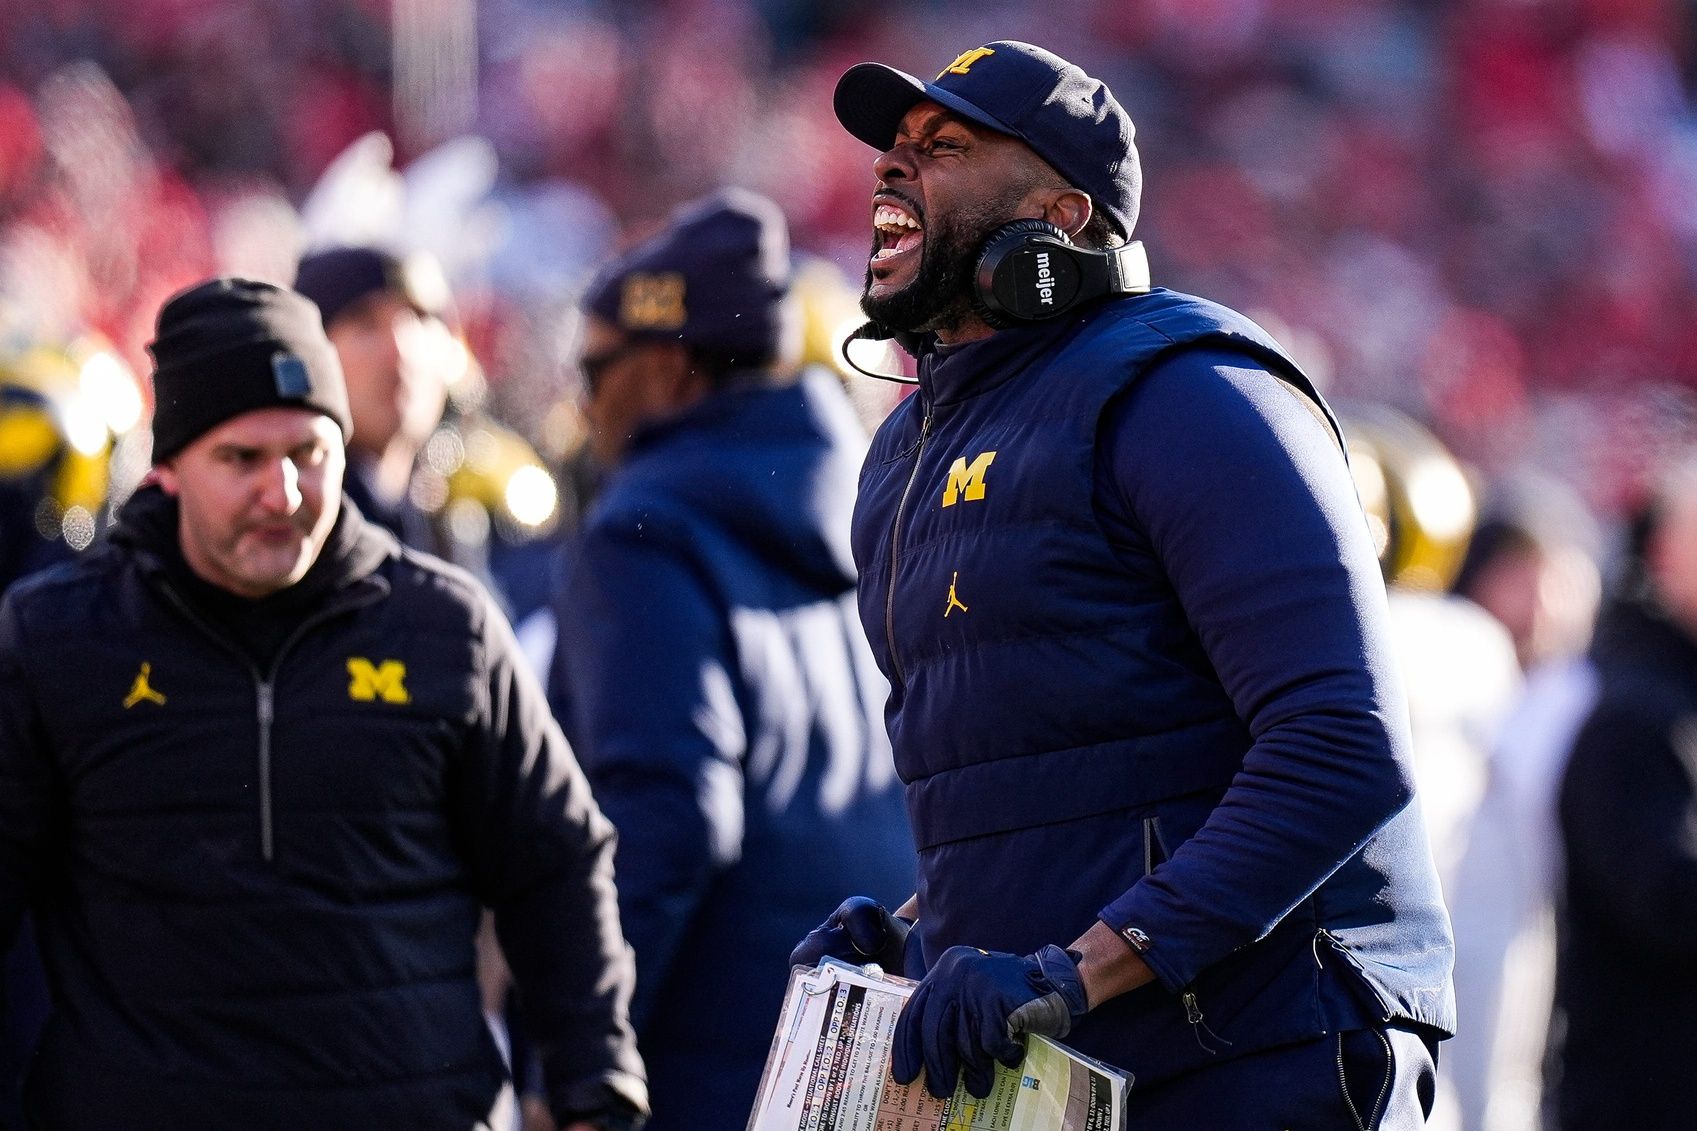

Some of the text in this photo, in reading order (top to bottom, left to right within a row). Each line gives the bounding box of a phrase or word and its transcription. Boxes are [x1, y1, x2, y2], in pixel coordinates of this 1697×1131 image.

[1035, 252, 1056, 305] meijer
[942, 451, 997, 508] M
[346, 657, 411, 704] M
[829, 1015, 840, 1034] OPP
[837, 1040, 844, 1049] UP
[828, 1099, 838, 1125] CONSULT
[834, 1082, 842, 1098] BOOK
[840, 1036, 853, 1069] INDIVIDUAL
[848, 1002, 861, 1037] SITUATIONS
[855, 1103, 861, 1111] TO
[869, 1042, 875, 1050] TO
[874, 1006, 884, 1030] WARNING
[805, 1067, 818, 1104] SITUATIONAL
[817, 1034, 826, 1052] SHEET
[849, 1067, 855, 1075] TO
[816, 1073, 827, 1091] OPP
[827, 1082, 834, 1091] BY
[823, 1091, 832, 1111] DOWN
[869, 1086, 879, 1111] WARNING
[882, 1084, 891, 1104] DON'T
[862, 1103, 868, 1111] OR
[898, 1097, 906, 1111] 2:00
[916, 1098, 924, 1115] FIRST
[943, 1095, 951, 1114] CLOCK
[989, 1115, 997, 1128] EACH
